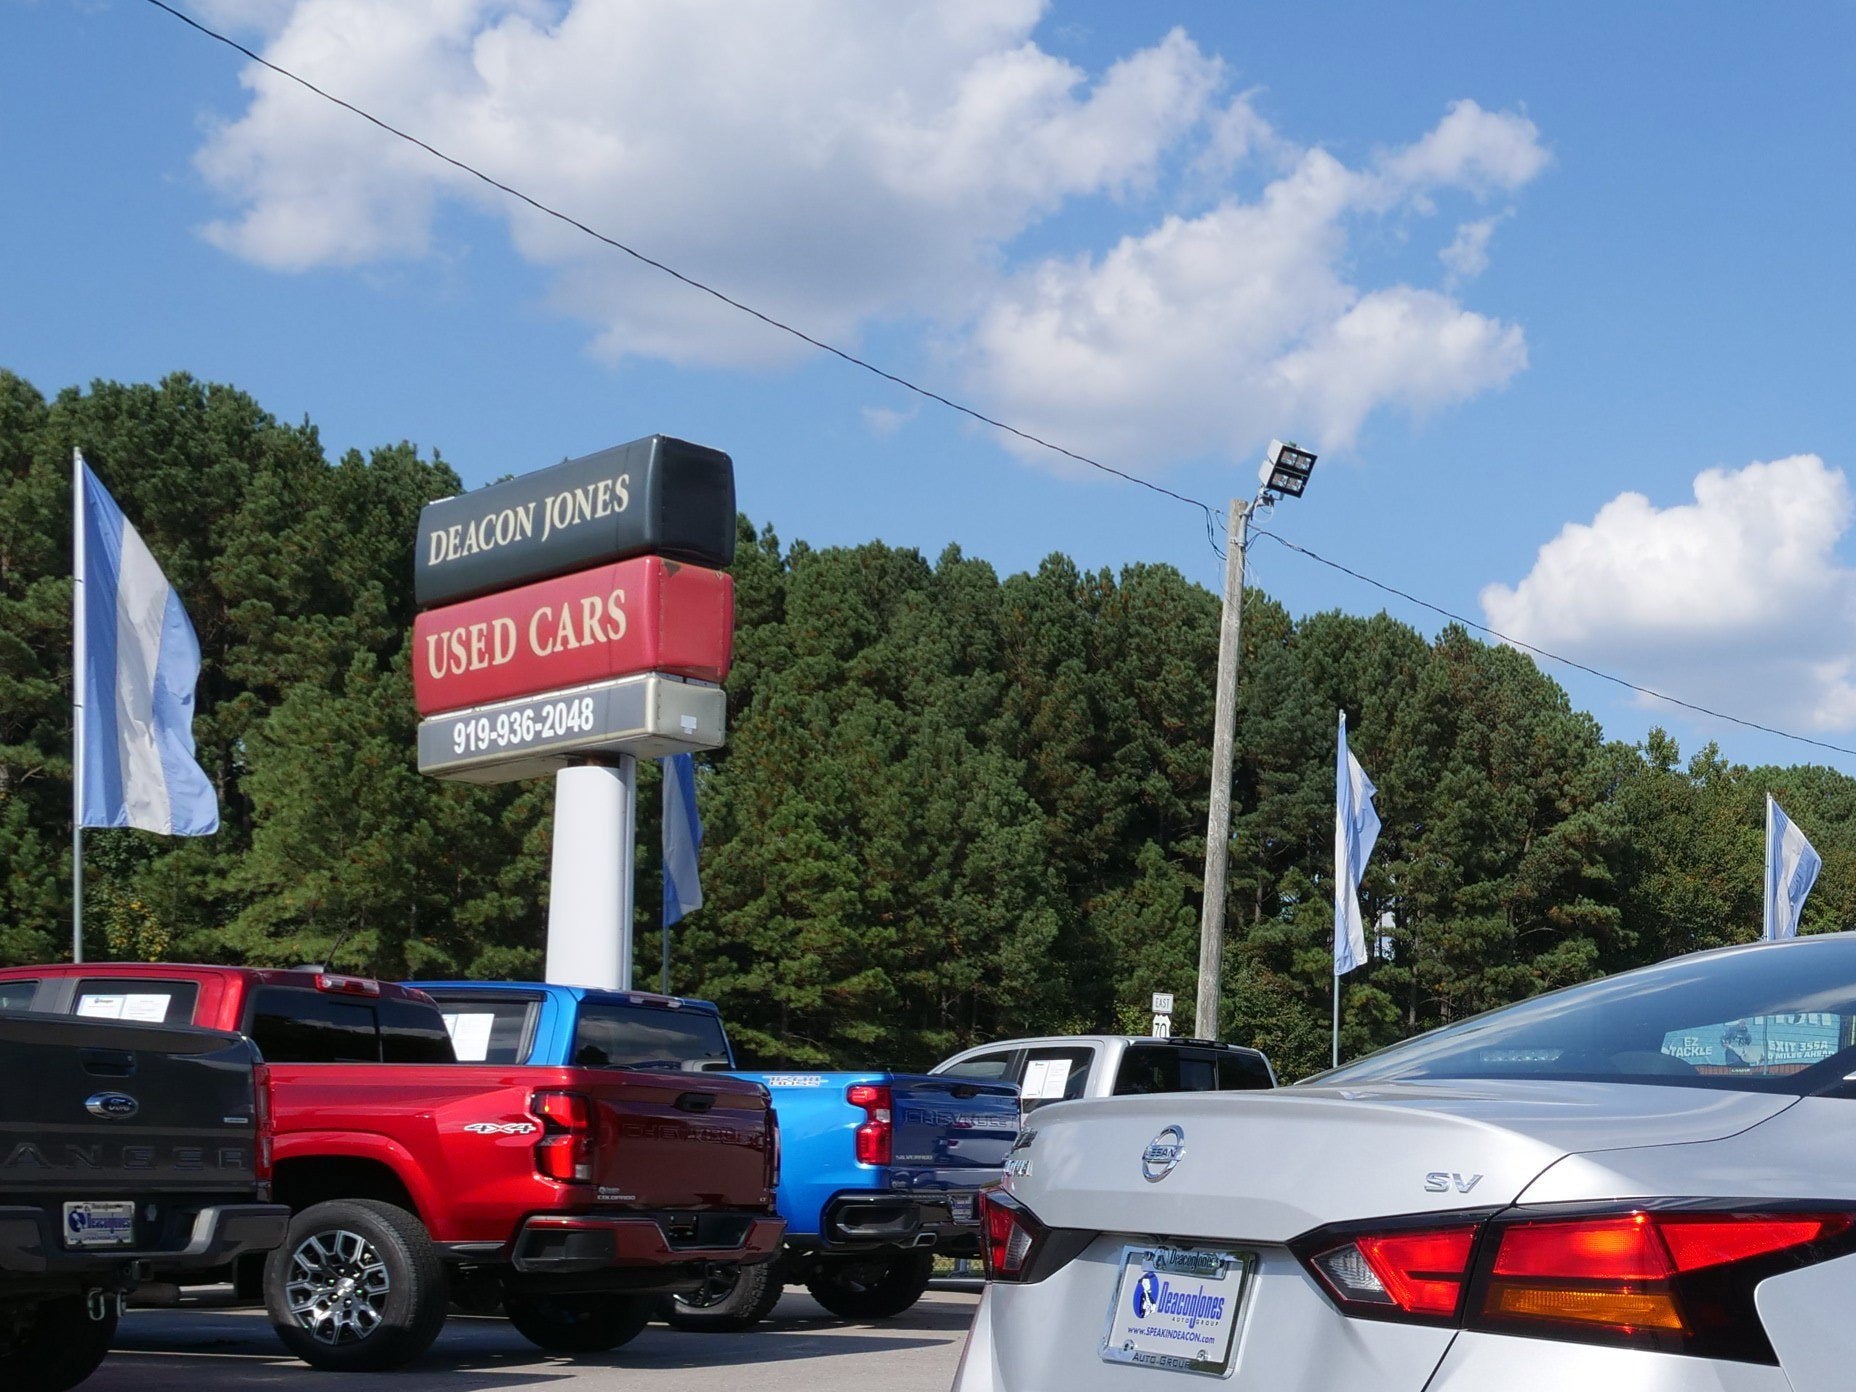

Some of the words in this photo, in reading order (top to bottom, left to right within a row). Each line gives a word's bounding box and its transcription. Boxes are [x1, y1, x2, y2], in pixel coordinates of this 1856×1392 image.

[427, 502, 536, 566] DEACON
[541, 473, 629, 542] JONES
[426, 617, 517, 679] USED
[529, 589, 627, 657] CARS
[453, 697, 594, 754] 919-936-2048
[1155, 997, 1170, 1009] EAST
[1155, 1022, 1167, 1038] 70
[1683, 1036, 1699, 1047] EZ
[1767, 1040, 1796, 1052] EXIT
[1799, 1041, 1829, 1051] 355A
[1670, 1046, 1713, 1058] TACKLE
[1424, 1172, 1484, 1194] SV
[1172, 1316, 1190, 1324] AUTO
[1195, 1319, 1220, 1327] GROUP
[1127, 1326, 1215, 1344] www.SPEAKINDEACON.com
[1132, 1352, 1157, 1364] AUTO
